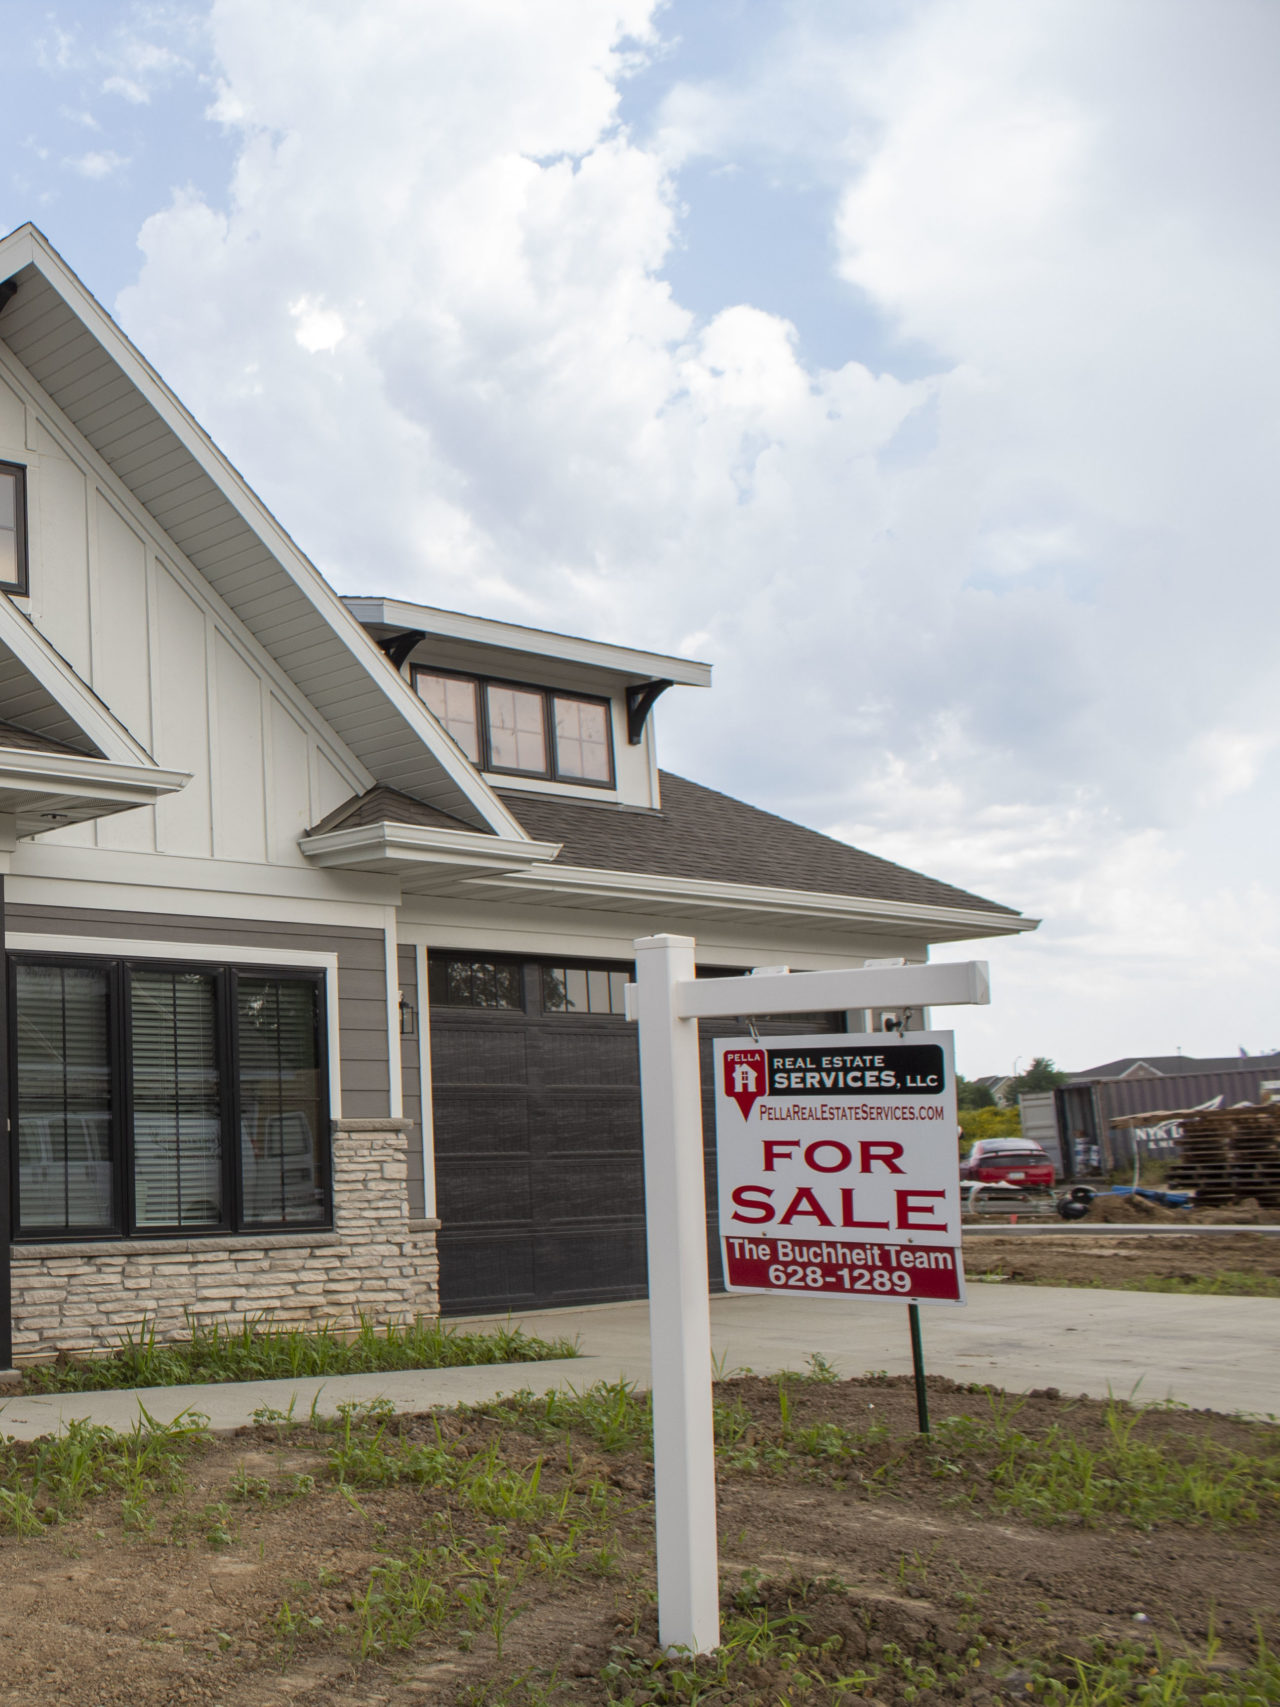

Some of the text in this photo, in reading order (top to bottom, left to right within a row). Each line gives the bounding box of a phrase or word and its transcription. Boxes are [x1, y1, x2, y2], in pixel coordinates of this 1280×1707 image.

[727, 1053, 761, 1062] PELLA
[773, 1055, 885, 1069] REAL ESTATE
[773, 1071, 939, 1089] SERVICES, LLC
[761, 1139, 907, 1174] FOR
[731, 1185, 948, 1233] SALE
[729, 1238, 953, 1270] The Buchheit Team
[768, 1264, 912, 1293] 628-1289
